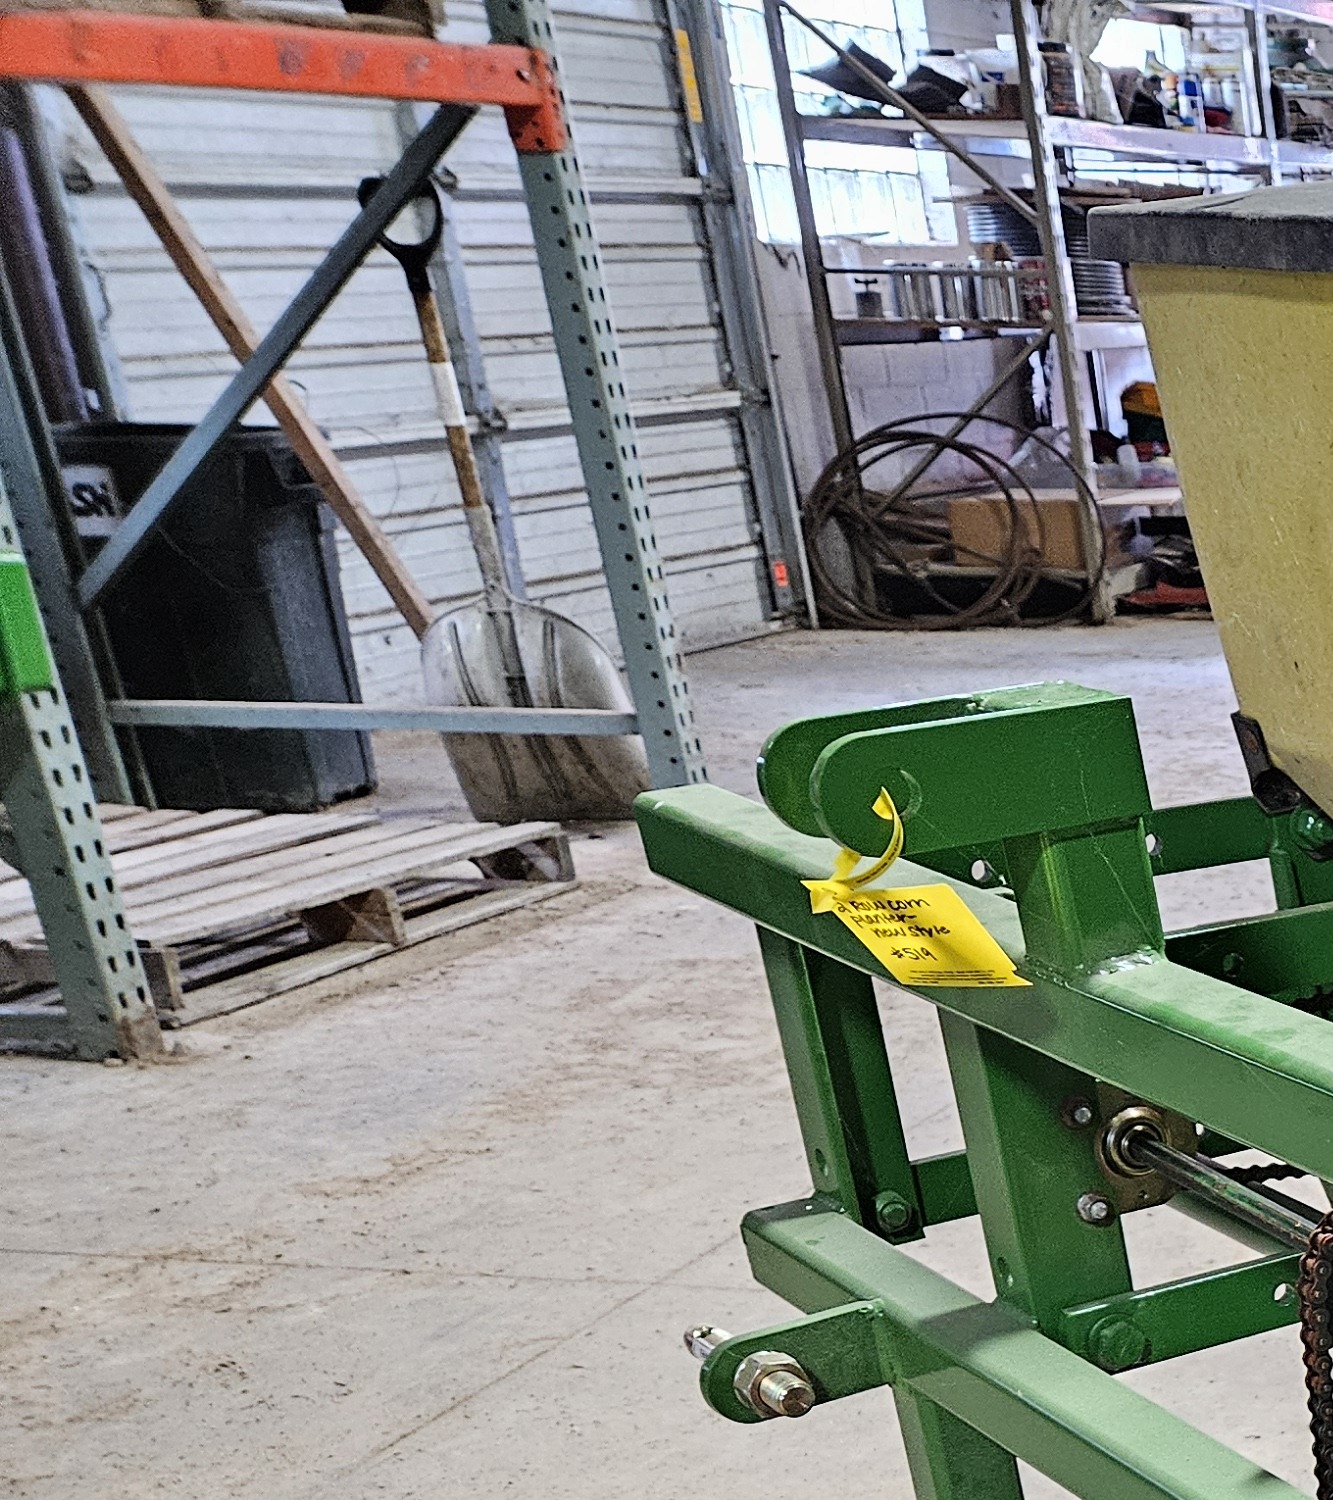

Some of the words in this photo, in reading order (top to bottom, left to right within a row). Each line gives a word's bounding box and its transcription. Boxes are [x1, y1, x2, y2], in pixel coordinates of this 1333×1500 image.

[836, 901, 852, 914] 2
[870, 926, 907, 939] new
[908, 924, 951, 938] style
